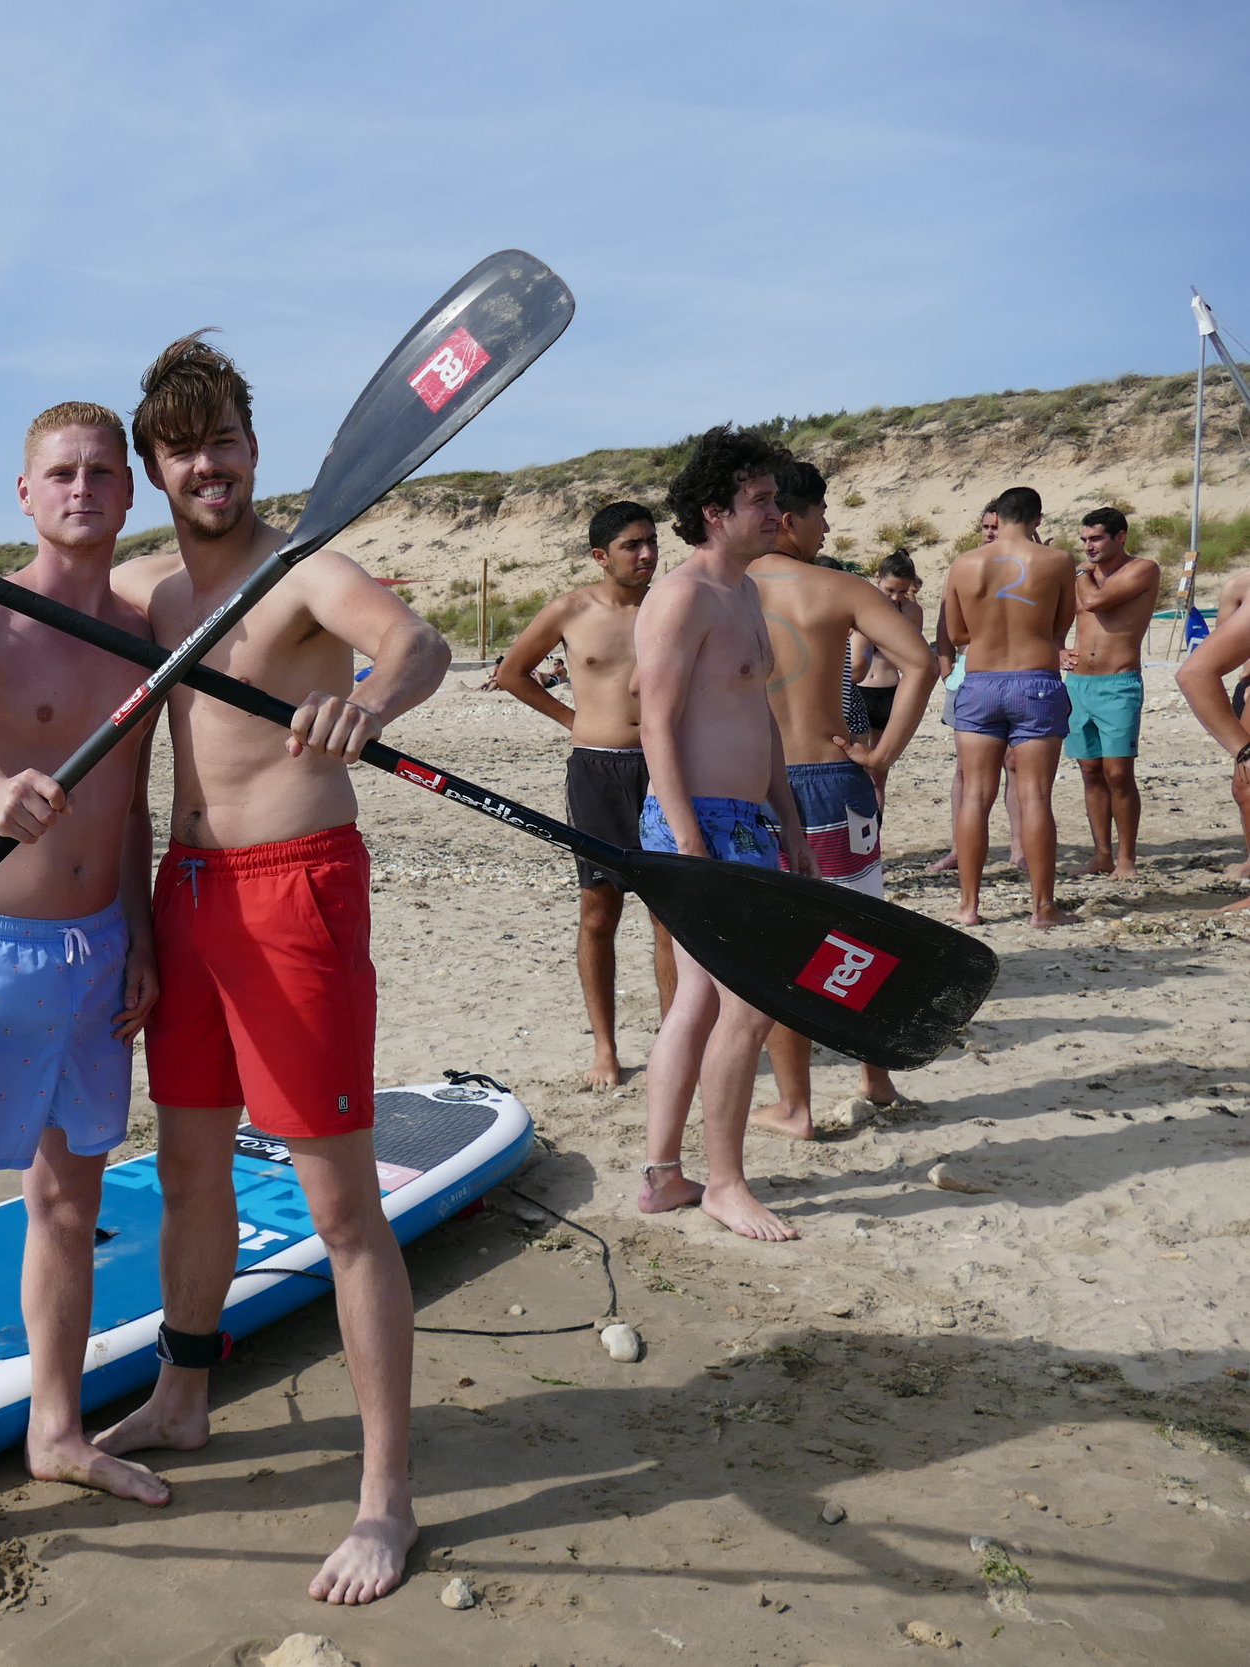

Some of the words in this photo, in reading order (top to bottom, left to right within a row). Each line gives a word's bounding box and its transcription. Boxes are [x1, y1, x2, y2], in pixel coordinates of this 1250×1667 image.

[410, 347, 469, 390] red
[993, 556, 1038, 606] 2
[114, 687, 143, 719] red
[401, 769, 441, 790] red
[823, 934, 875, 998] red
